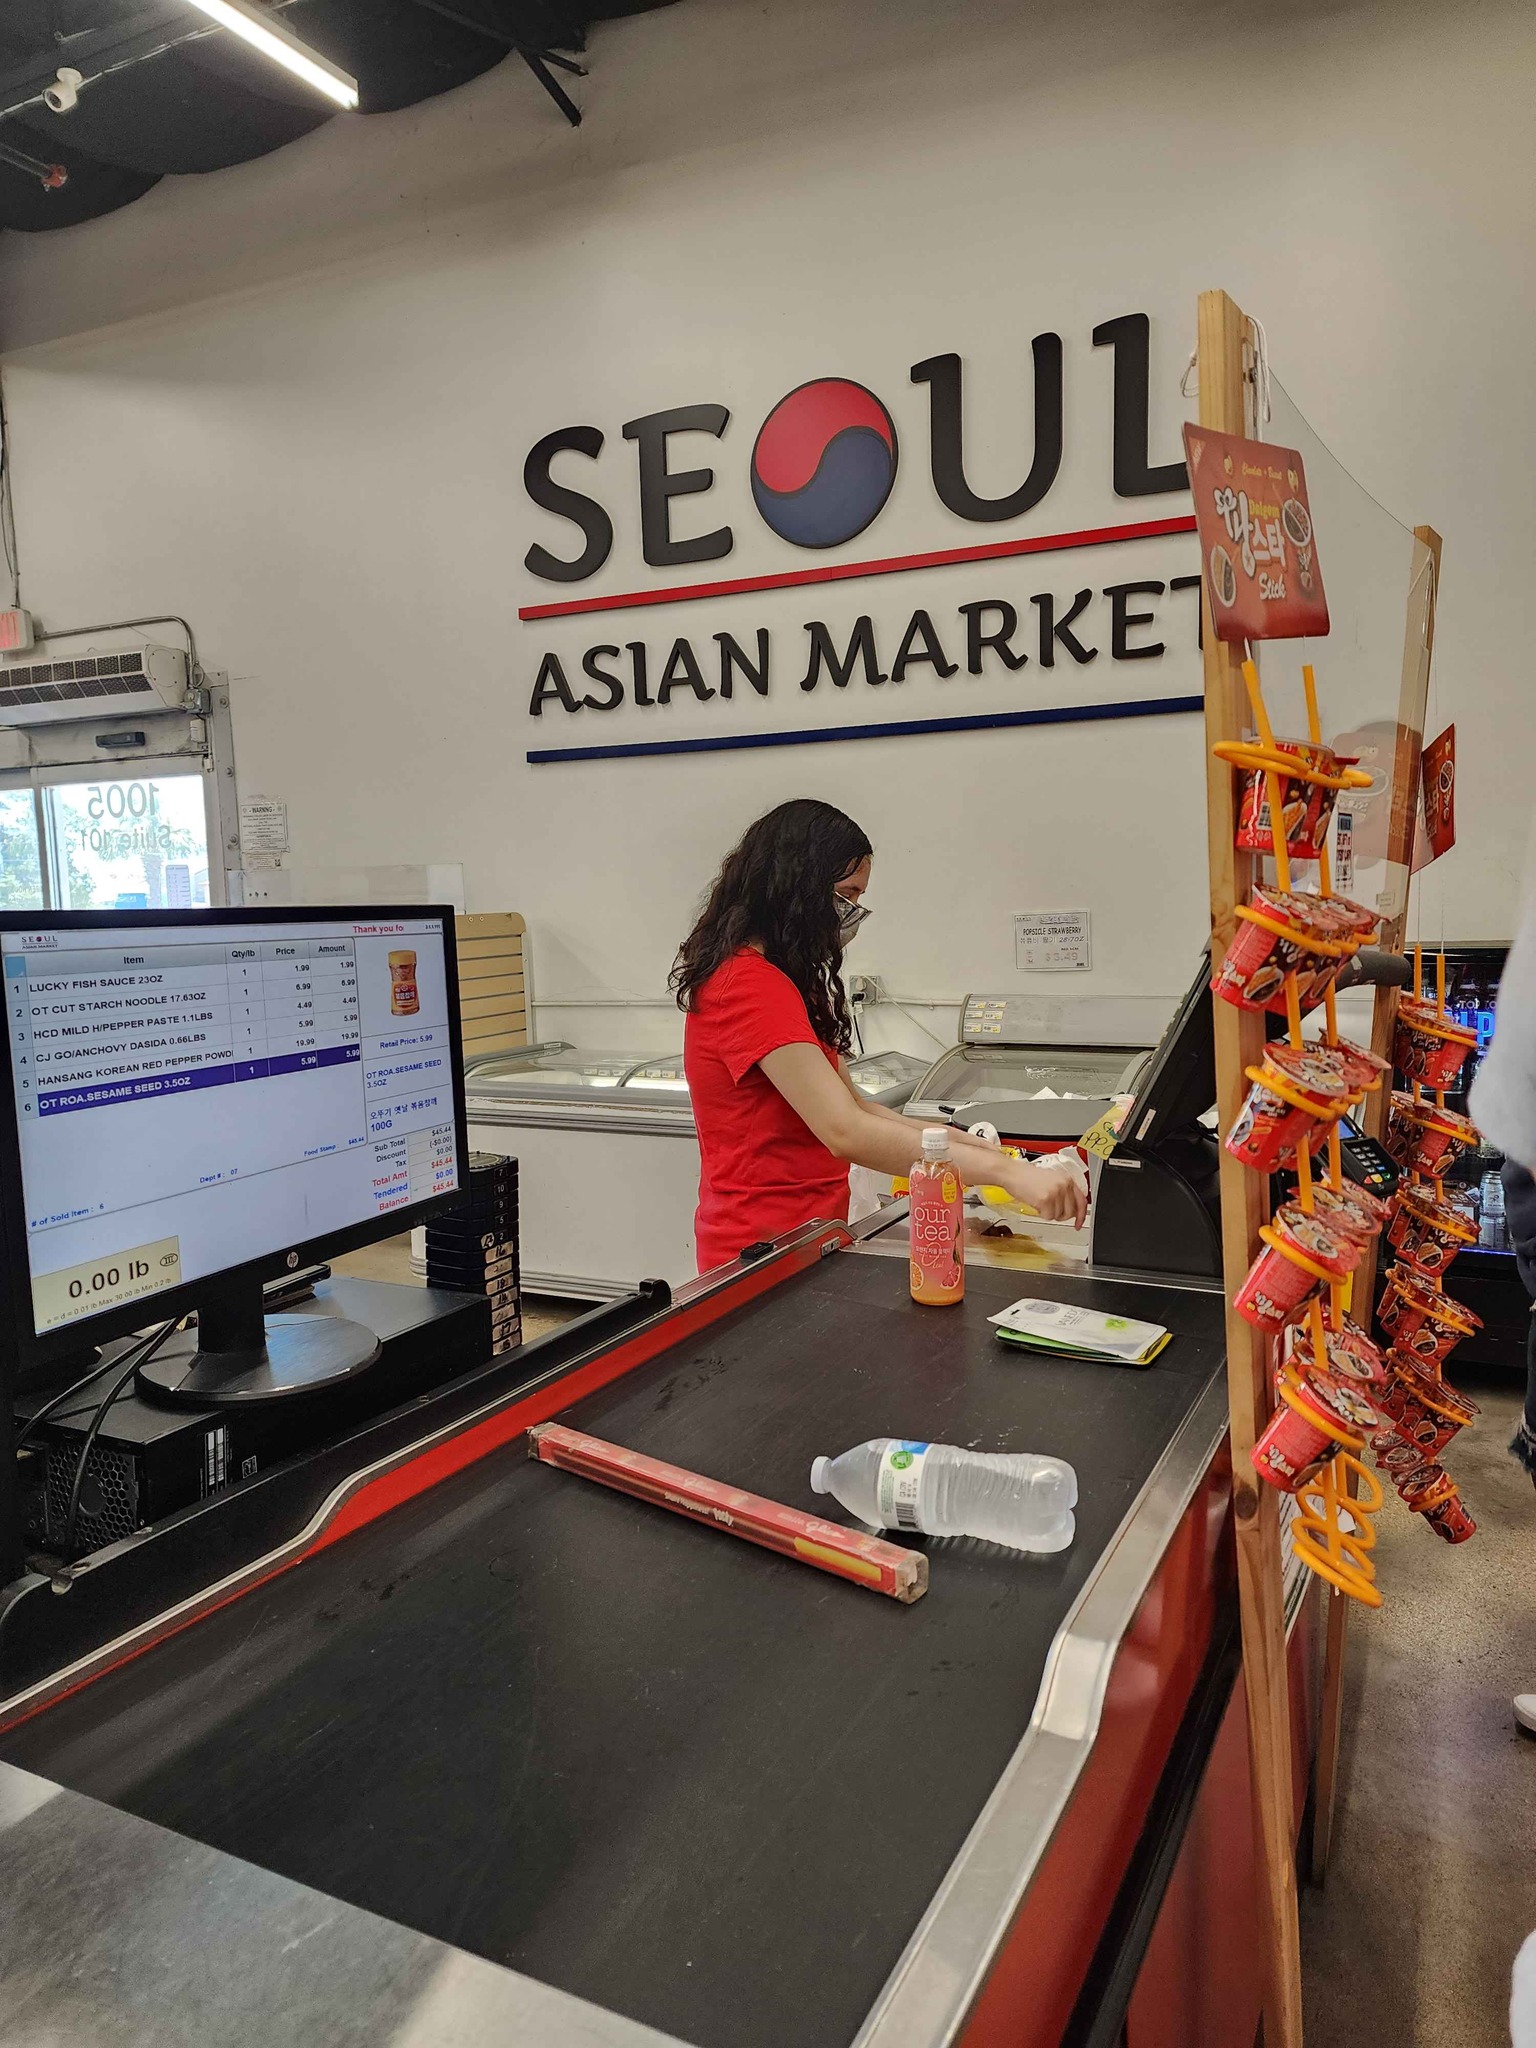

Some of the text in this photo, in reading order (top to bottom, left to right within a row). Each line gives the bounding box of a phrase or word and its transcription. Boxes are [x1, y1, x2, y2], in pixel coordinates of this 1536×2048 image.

[524, 312, 1191, 582] SEOUL
[1259, 571, 1286, 600] Stick
[528, 628, 770, 717] ASIAN
[353, 925, 377, 933] Thank
[379, 926, 393, 934] you
[1022, 926, 1082, 936] POPSICLE STRAWBERRY
[231, 950, 255, 959] Qty/lb
[14, 985, 20, 994] 1
[30, 982, 69, 992] LUCKY
[72, 980, 96, 989] FISH
[100, 977, 135, 987] SAUCE
[138, 975, 163, 984] 23OZ
[16, 1009, 23, 1018] 2
[32, 1007, 48, 1016] OT
[52, 1004, 75, 1014] CUT
[78, 1001, 122, 1012] STARCH
[125, 996, 167, 1007] NOODLE
[18, 1032, 25, 1041] 3
[34, 1030, 58, 1040] HCD
[62, 1026, 89, 1036] MILD
[92, 1020, 144, 1032] H/PEPPER
[147, 1016, 179, 1026] PASTE
[182, 1012, 213, 1022] 1.1LBS
[20, 1056, 27, 1065] 4
[36, 1053, 51, 1063] CJ
[54, 1044, 127, 1059] GO/ANCHOVY
[130, 1039, 167, 1050] DASIDA
[169, 1034, 206, 1045] 0.66LBS
[380, 1040, 398, 1049] Retail
[400, 1038, 418, 1046] Price:
[22, 1080, 29, 1088] 5
[38, 1071, 93, 1086] HANSANG
[96, 1064, 140, 1077] KOREAN
[142, 1061, 162, 1070] RED
[165, 1054, 203, 1067] PEPPER
[296, 1038, 314, 1047] 19.99
[342, 1032, 358, 1040] 19.99
[378, 1063, 423, 1077] ROA.SESAME
[425, 1059, 442, 1068] SEED
[24, 1103, 31, 1112] 6
[40, 1099, 58, 1109] OT
[60, 1086, 132, 1106] ROA.SESAME
[135, 1082, 162, 1094] SEED
[164, 1077, 191, 1088] 3.5OZ
[301, 1057, 316, 1065] 5.99
[346, 1049, 360, 1058] 5.99
[367, 1080, 387, 1088] 3.5OZ
[371, 1120, 392, 1132] 100G
[374, 1126, 451, 1152] Sub Total $45.44
[304, 1147, 318, 1156] Food
[320, 1144, 336, 1153] Stamp
[376, 1150, 406, 1162] Discount
[395, 1145, 452, 1167] Tax $0.00
[200, 1175, 214, 1184] Dept
[372, 1157, 452, 1187] Total Amt $45.44
[374, 1168, 453, 1200] Tendered $0.00
[380, 1180, 454, 1211] Balance $45.44
[40, 1218, 48, 1226] of
[50, 1212, 69, 1223] Sold
[71, 1208, 89, 1218] Item
[914, 1207, 950, 1223] our
[69, 1260, 149, 1298] 0.00 lb
[98, 1298, 113, 1308] Max
